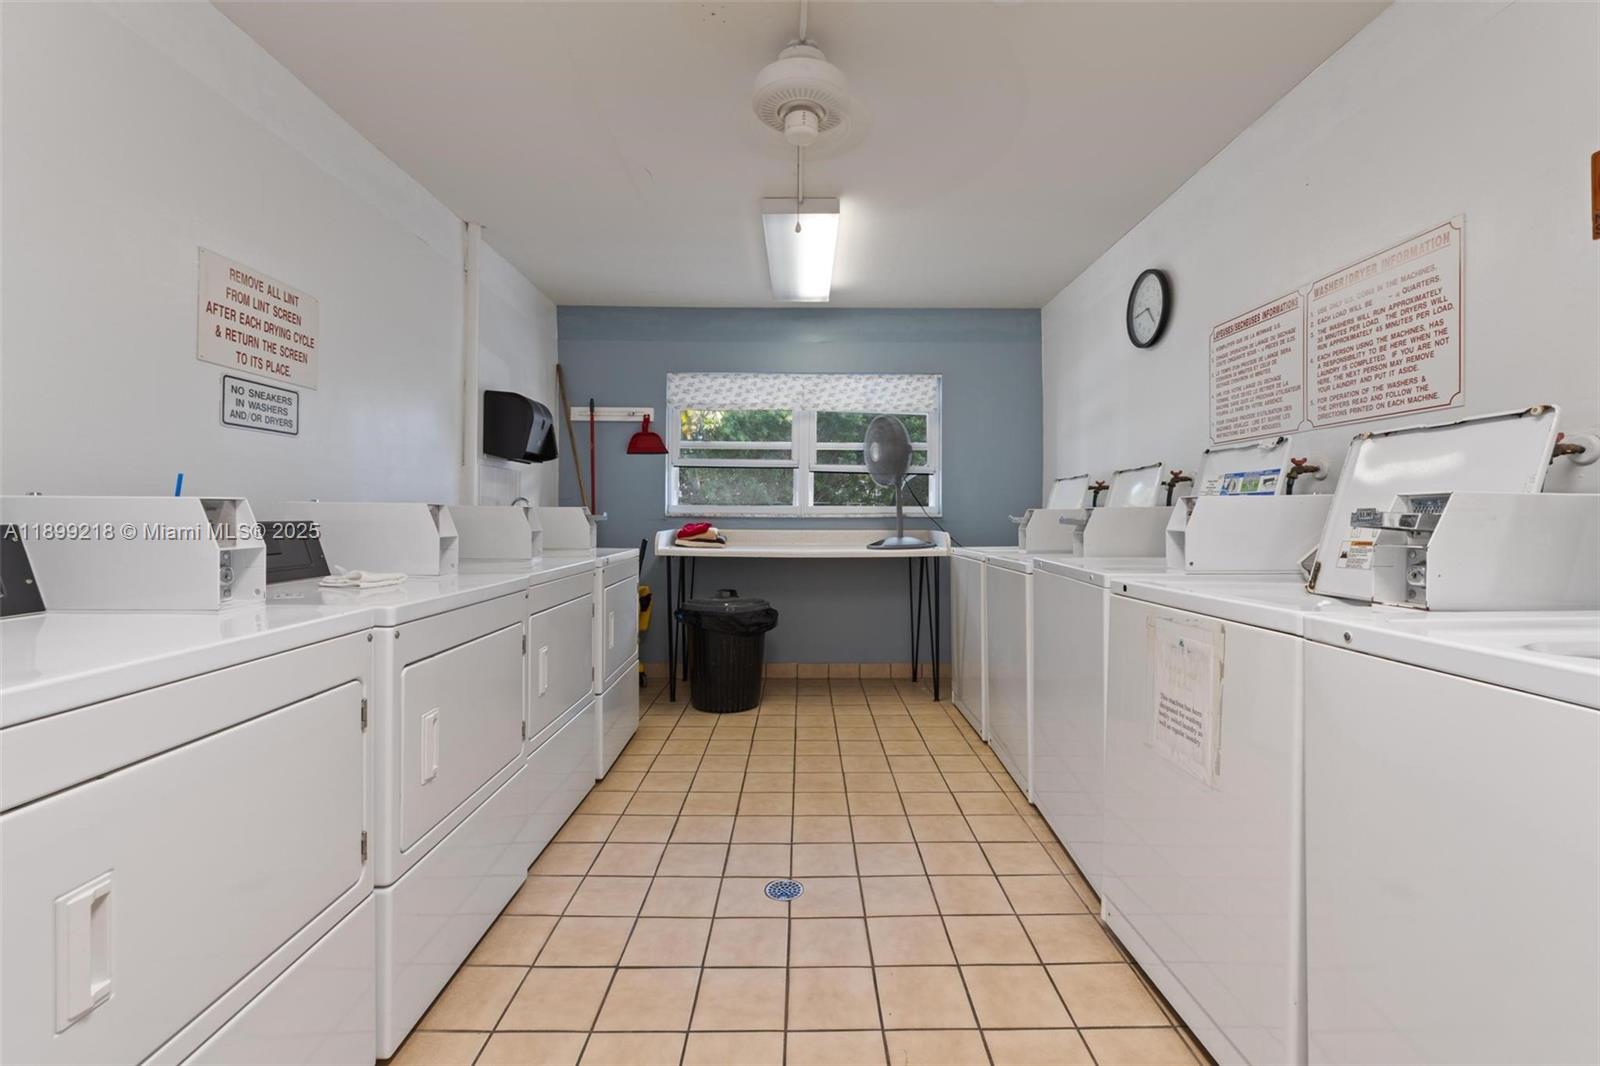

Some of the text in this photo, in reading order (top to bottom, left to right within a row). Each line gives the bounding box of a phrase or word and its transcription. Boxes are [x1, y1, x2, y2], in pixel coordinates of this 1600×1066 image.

[1382, 231, 1450, 268] INFORMATION
[230, 268, 299, 306] REMOVE ALL LINT
[1386, 278, 1397, 288] THE
[226, 287, 302, 326] FROM LINT SCREEN
[1317, 327, 1326, 335] THE
[1329, 317, 1354, 331] WASHERS
[1357, 312, 1370, 321] WILL
[1373, 306, 1385, 316] RUN
[1388, 286, 1442, 311] APPROXIMATELY
[1317, 315, 1330, 324] EACH
[1332, 309, 1346, 319] LOAD
[1349, 303, 1362, 313] WILL
[1324, 328, 1347, 340] MINUTES
[1349, 324, 1360, 332] PER
[1385, 311, 1397, 320] THE
[1400, 301, 1427, 315] DRYERS
[1430, 294, 1447, 306] WILL
[206, 300, 315, 348] AFTER EACH DRYING CYCLE
[1317, 352, 1330, 360] EACH
[1332, 345, 1353, 356] PERSON
[1356, 339, 1373, 349] USING
[1376, 335, 1387, 343] THE
[1429, 318, 1443, 328] HAS
[1329, 328, 1372, 346] APPROXIMATELY
[1385, 315, 1412, 329] MINUTES
[1416, 310, 1429, 319] PER
[1433, 302, 1454, 314] LOAD.
[225, 327, 259, 349] RETURN
[262, 339, 277, 354] THE
[280, 345, 307, 363] SCREEN
[1317, 366, 1339, 376] LAUNDRY
[1400, 346, 1413, 355] YOU
[1417, 341, 1431, 350] ARE
[1434, 336, 1449, 346] NOT
[1323, 350, 1365, 367] RESPONSIBILITY
[1390, 339, 1406, 348] HERE
[1410, 332, 1430, 342] WHEN
[1434, 327, 1448, 336] THE
[250, 355, 263, 369] ITS
[266, 360, 291, 376] PLACE.
[1345, 369, 1360, 377] NEXT
[1363, 362, 1386, 373] PERSON
[1389, 358, 1402, 366] MAY
[1406, 350, 1433, 362] REMOVE
[248, 388, 292, 405] SNEAKERS
[1317, 384, 1330, 392] YOUR
[1332, 378, 1356, 389] LAUNDRY
[1374, 371, 1385, 379] PUT
[1329, 389, 1359, 400] OPERATION
[1386, 377, 1418, 388] WASHERS
[1329, 400, 1349, 409] DRYERS
[1352, 396, 1367, 404] READ
[1371, 393, 1382, 401] AND
[1385, 387, 1411, 398] FOLLOW
[1416, 384, 1429, 392] THE
[229, 409, 292, 428] AND/OR DRYERS
[248, 400, 288, 416] WASHERS
[1317, 409, 1346, 419] DIRECTIONS
[1349, 404, 1373, 413] PRINTED
[1387, 398, 1404, 406] EACH
